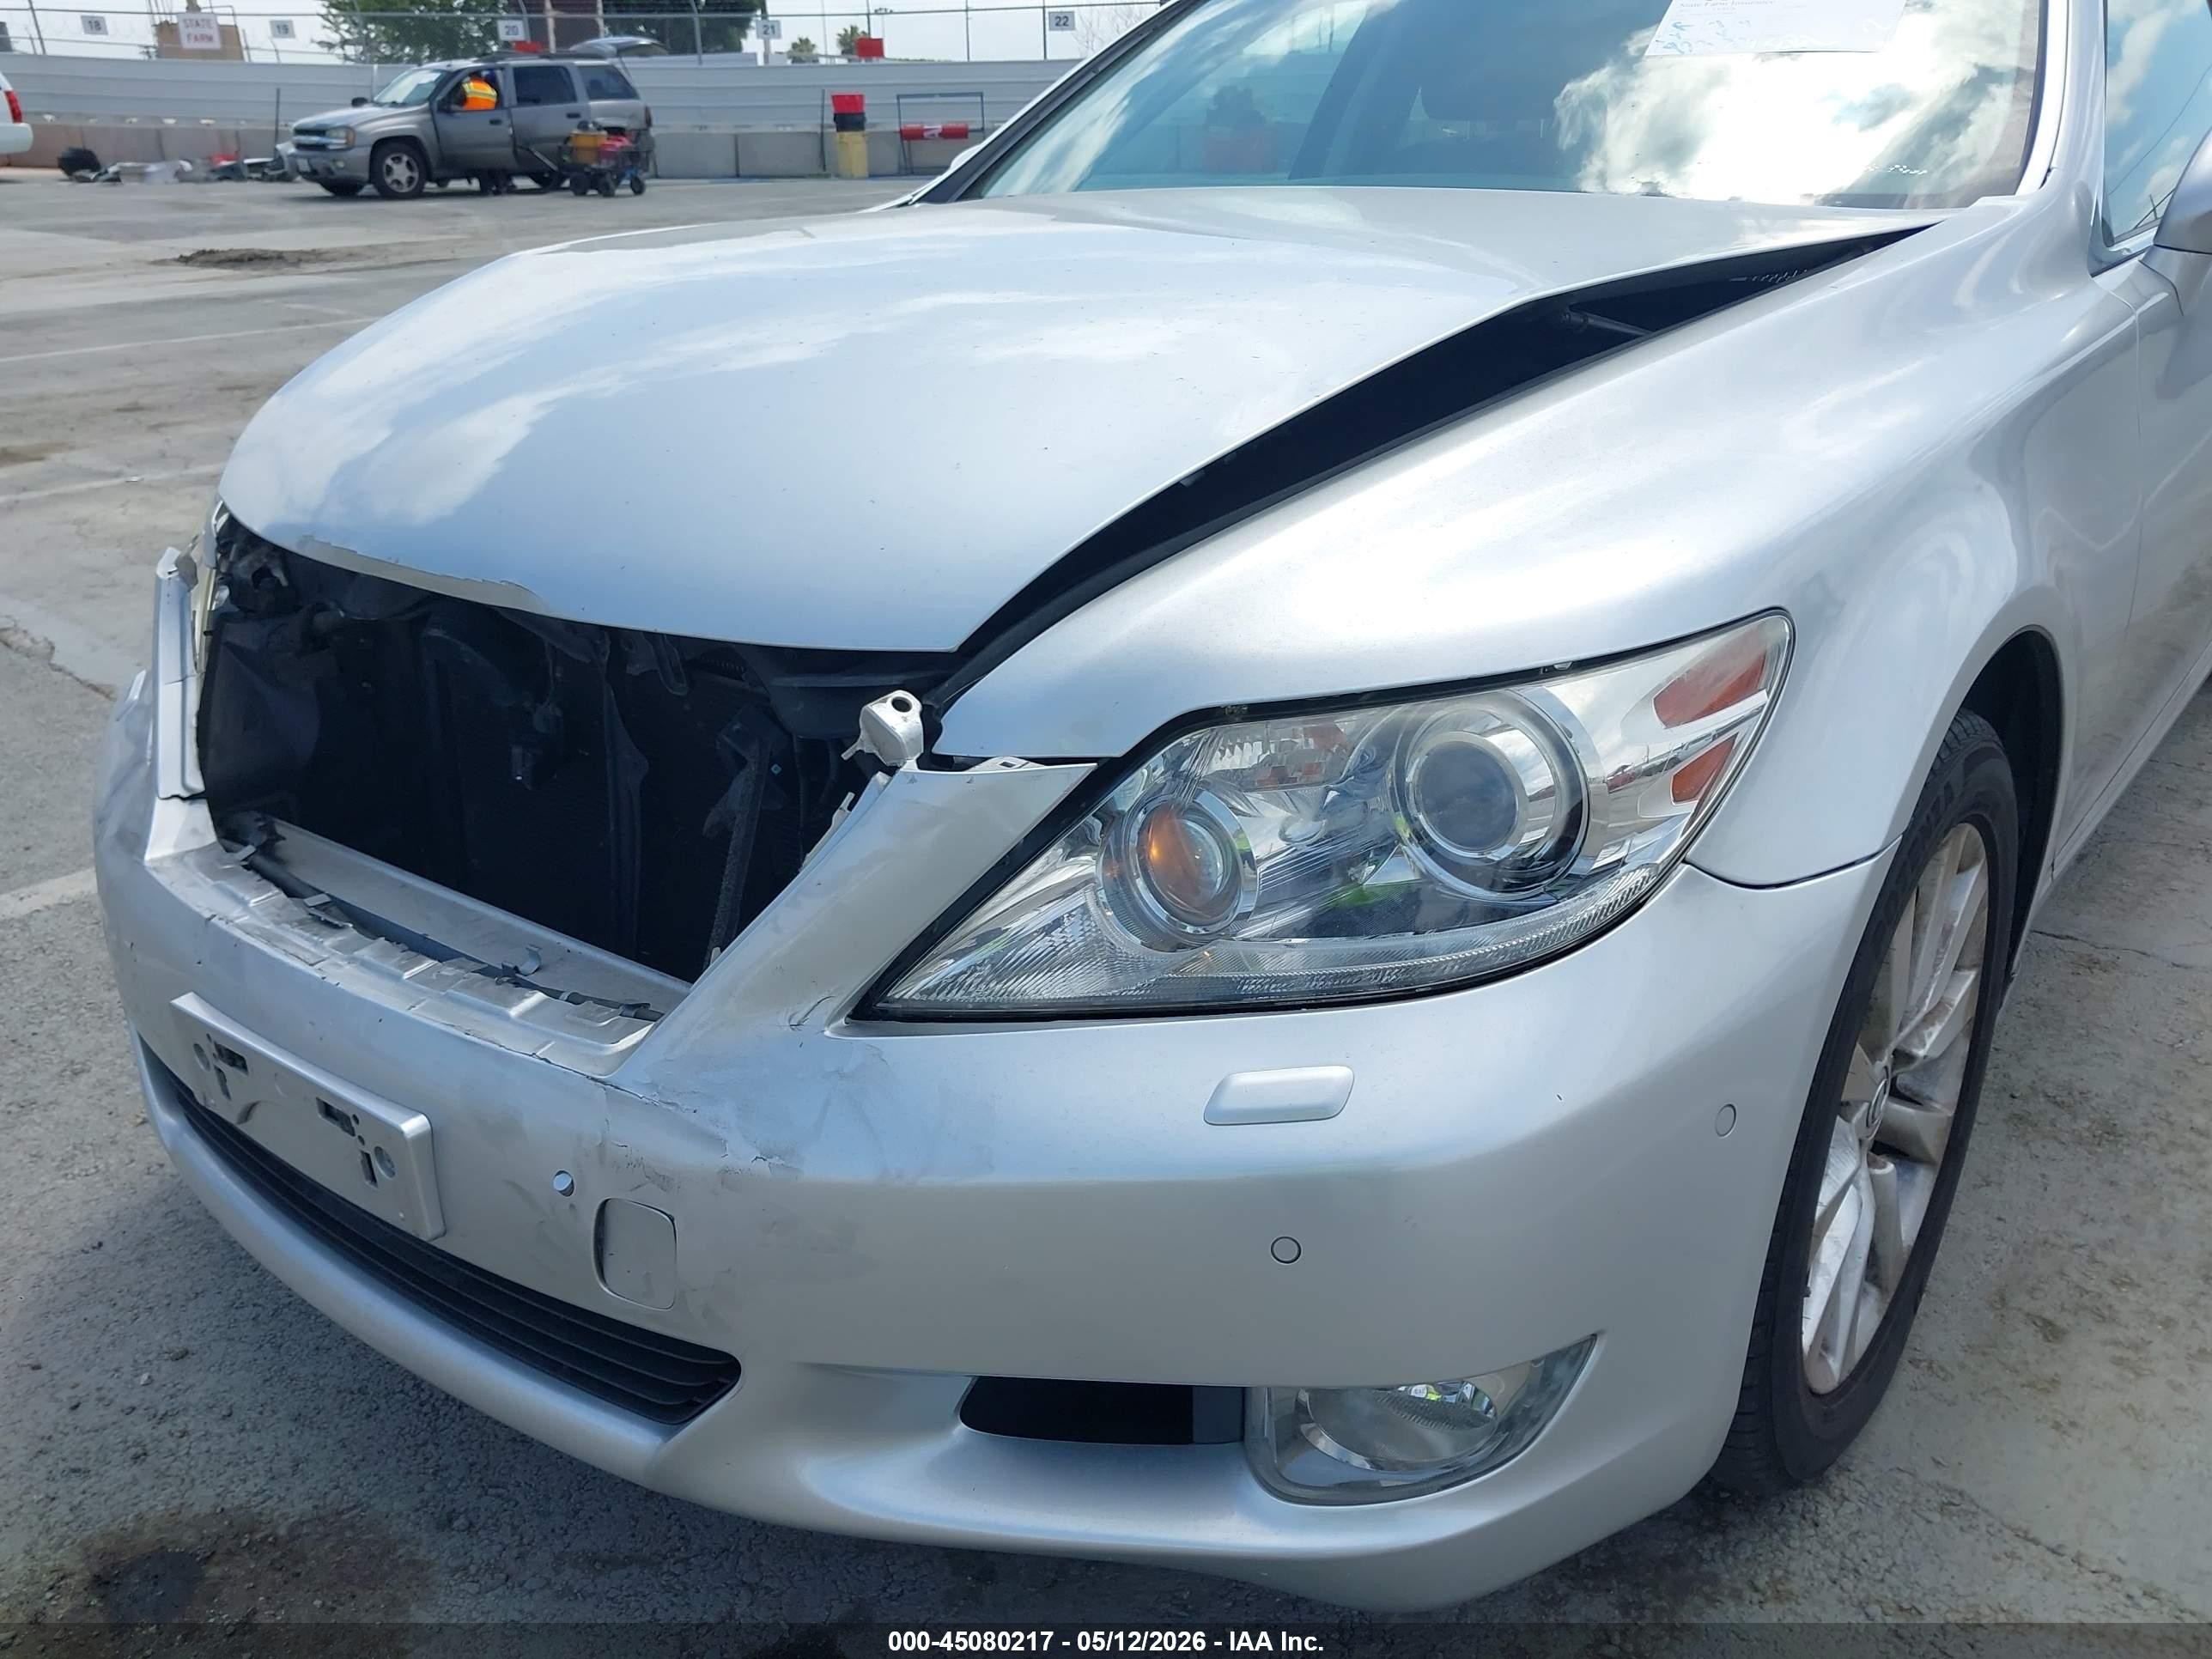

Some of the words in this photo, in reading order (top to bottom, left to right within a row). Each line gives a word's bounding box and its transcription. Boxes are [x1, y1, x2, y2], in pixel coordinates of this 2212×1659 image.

[88, 20, 101, 31] 18
[183, 19, 214, 29] STATE
[1054, 15, 1069, 27] 22
[504, 25, 519, 36] 20
[763, 24, 775, 35] 21
[186, 33, 214, 43] FARM
